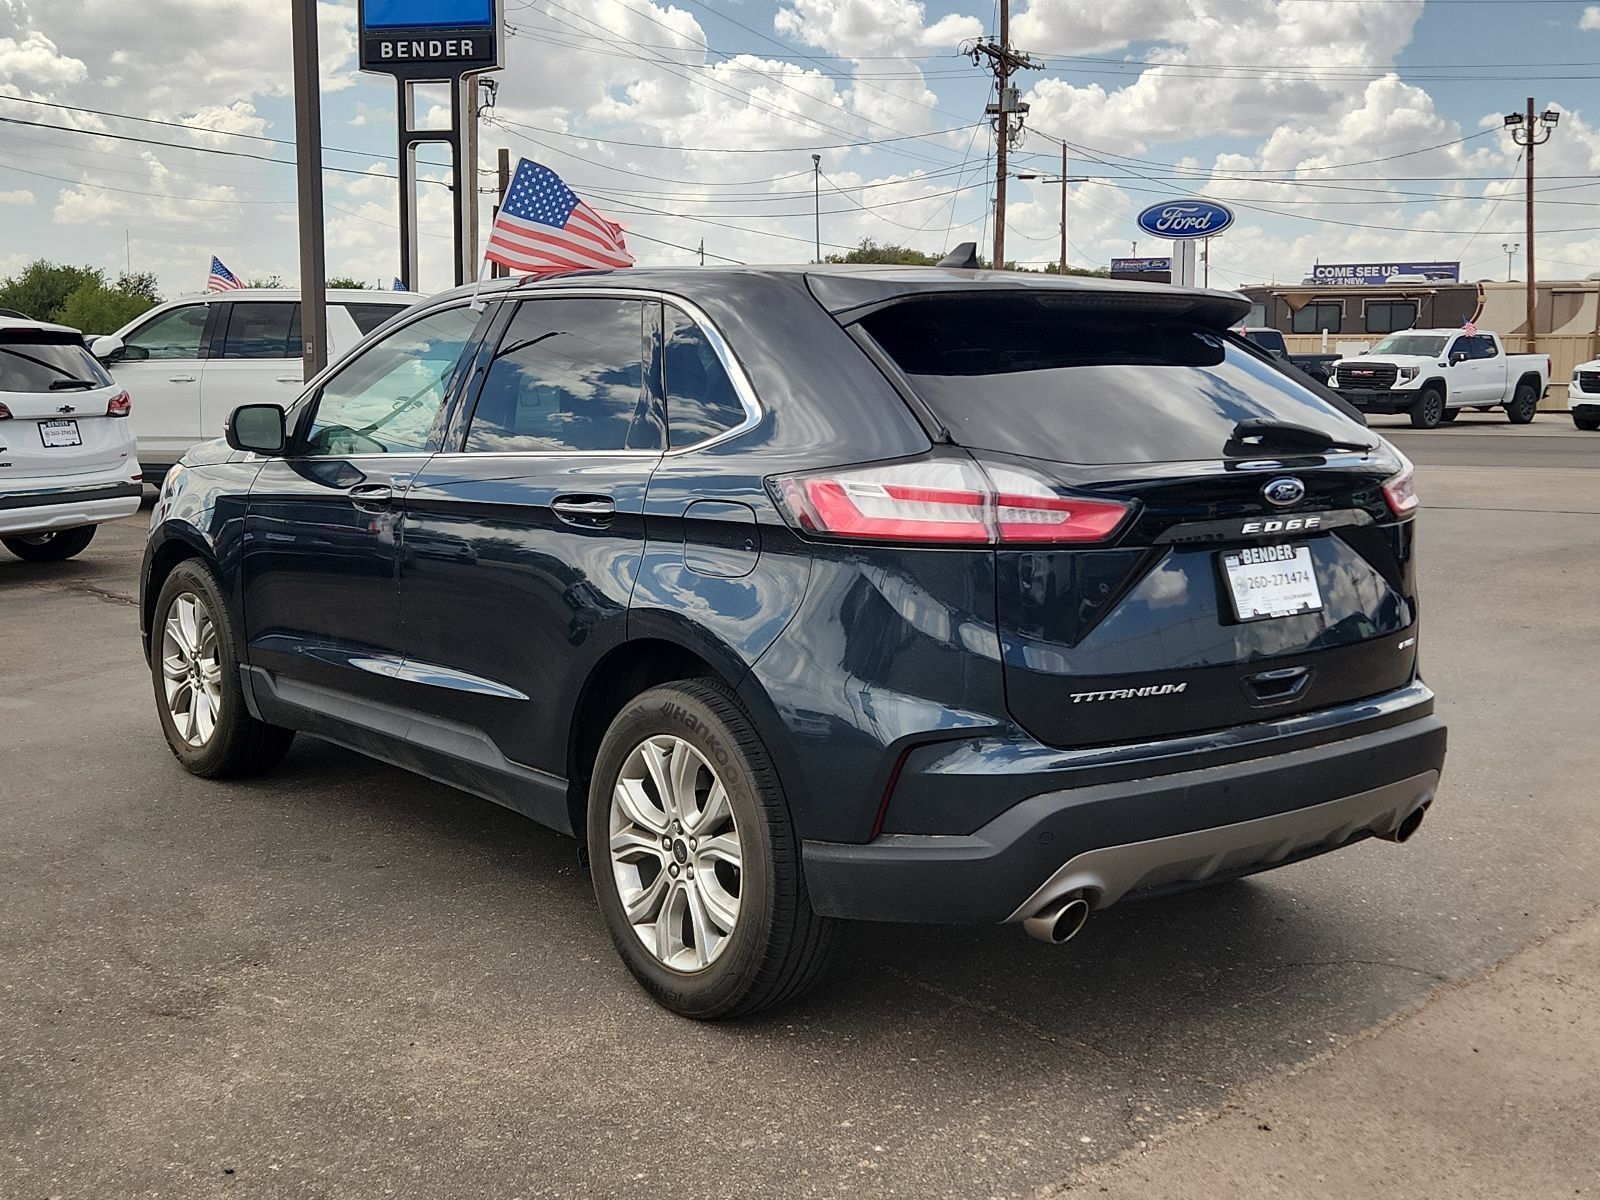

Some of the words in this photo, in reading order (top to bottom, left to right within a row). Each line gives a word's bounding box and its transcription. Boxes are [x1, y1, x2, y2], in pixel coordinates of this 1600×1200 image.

[380, 40, 473, 58] BENDER
[1156, 206, 1212, 230] Ford
[1315, 267, 1354, 278] COME
[1355, 266, 1379, 277] SEE
[1381, 265, 1399, 276] US
[1241, 517, 1321, 534] EDGE
[1242, 544, 1293, 565] BENDER
[1247, 570, 1310, 590] 26D-271474
[1070, 682, 1187, 703] TITANIUM
